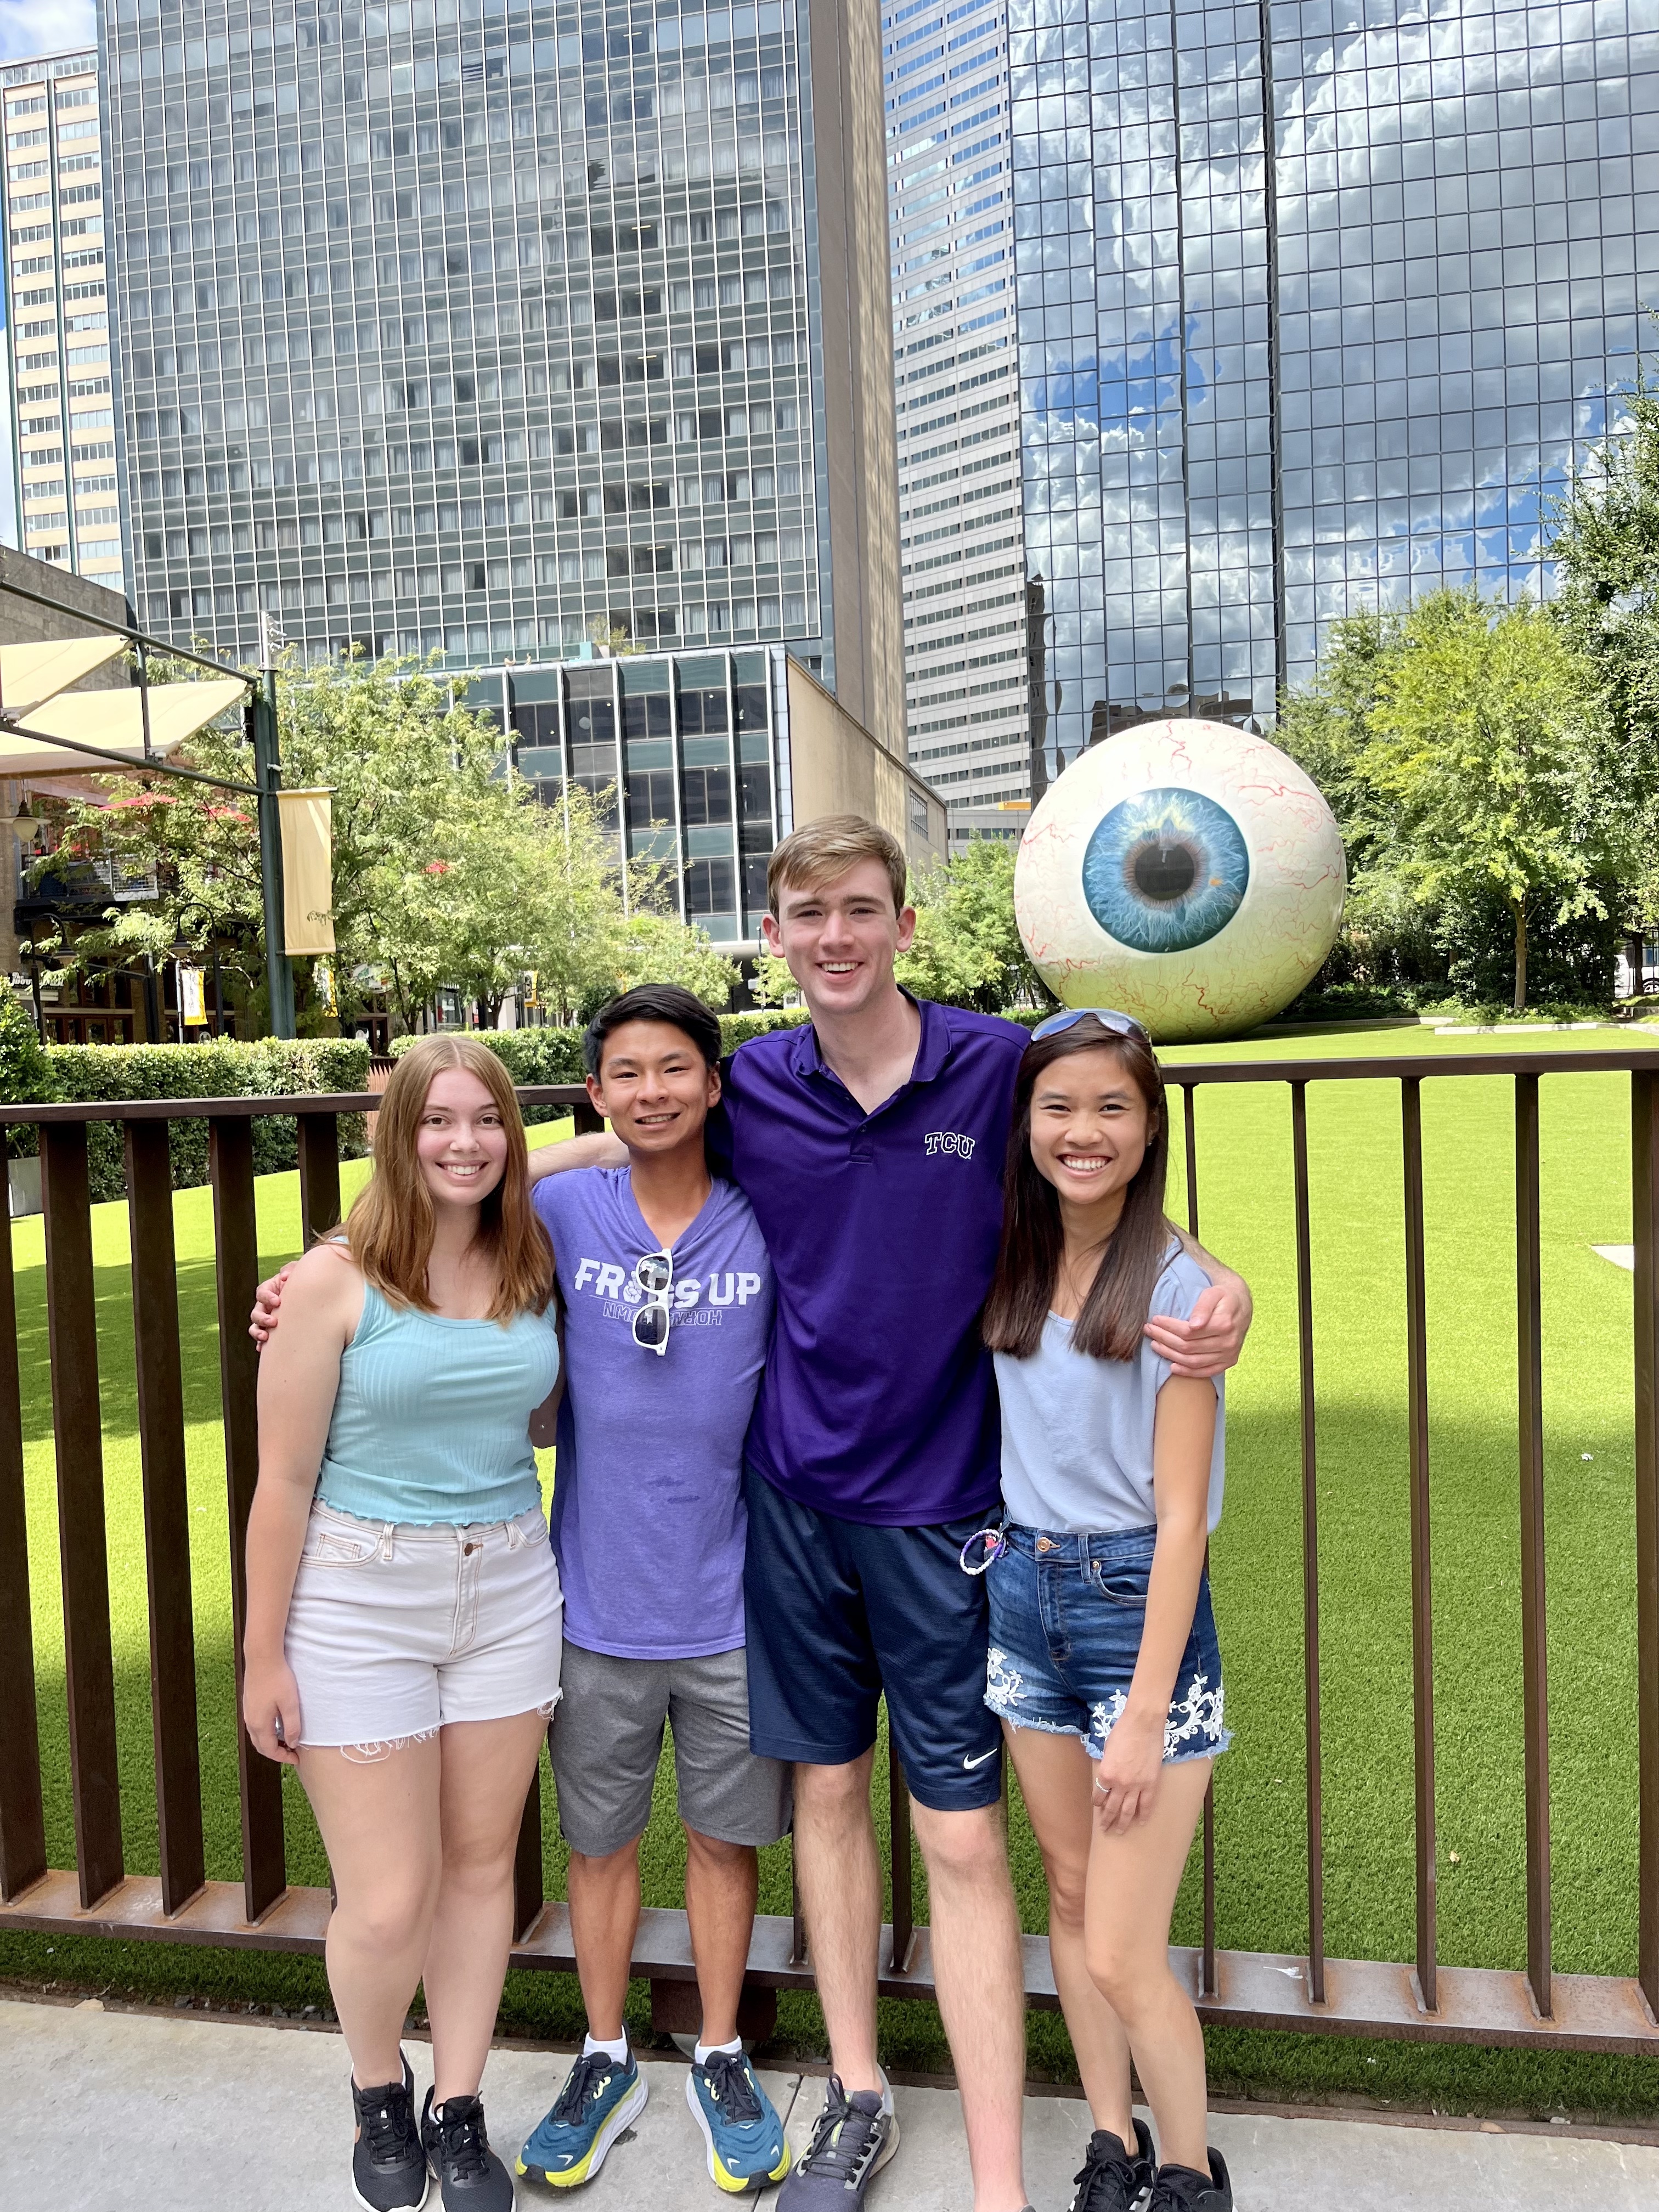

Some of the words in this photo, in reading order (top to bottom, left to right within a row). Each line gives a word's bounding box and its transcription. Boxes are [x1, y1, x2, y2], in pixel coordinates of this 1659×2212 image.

[924, 1132, 975, 1159] TCU
[708, 1272, 761, 1306] UP
[603, 1301, 639, 1323] OWN
[669, 1310, 722, 1326] HORN
